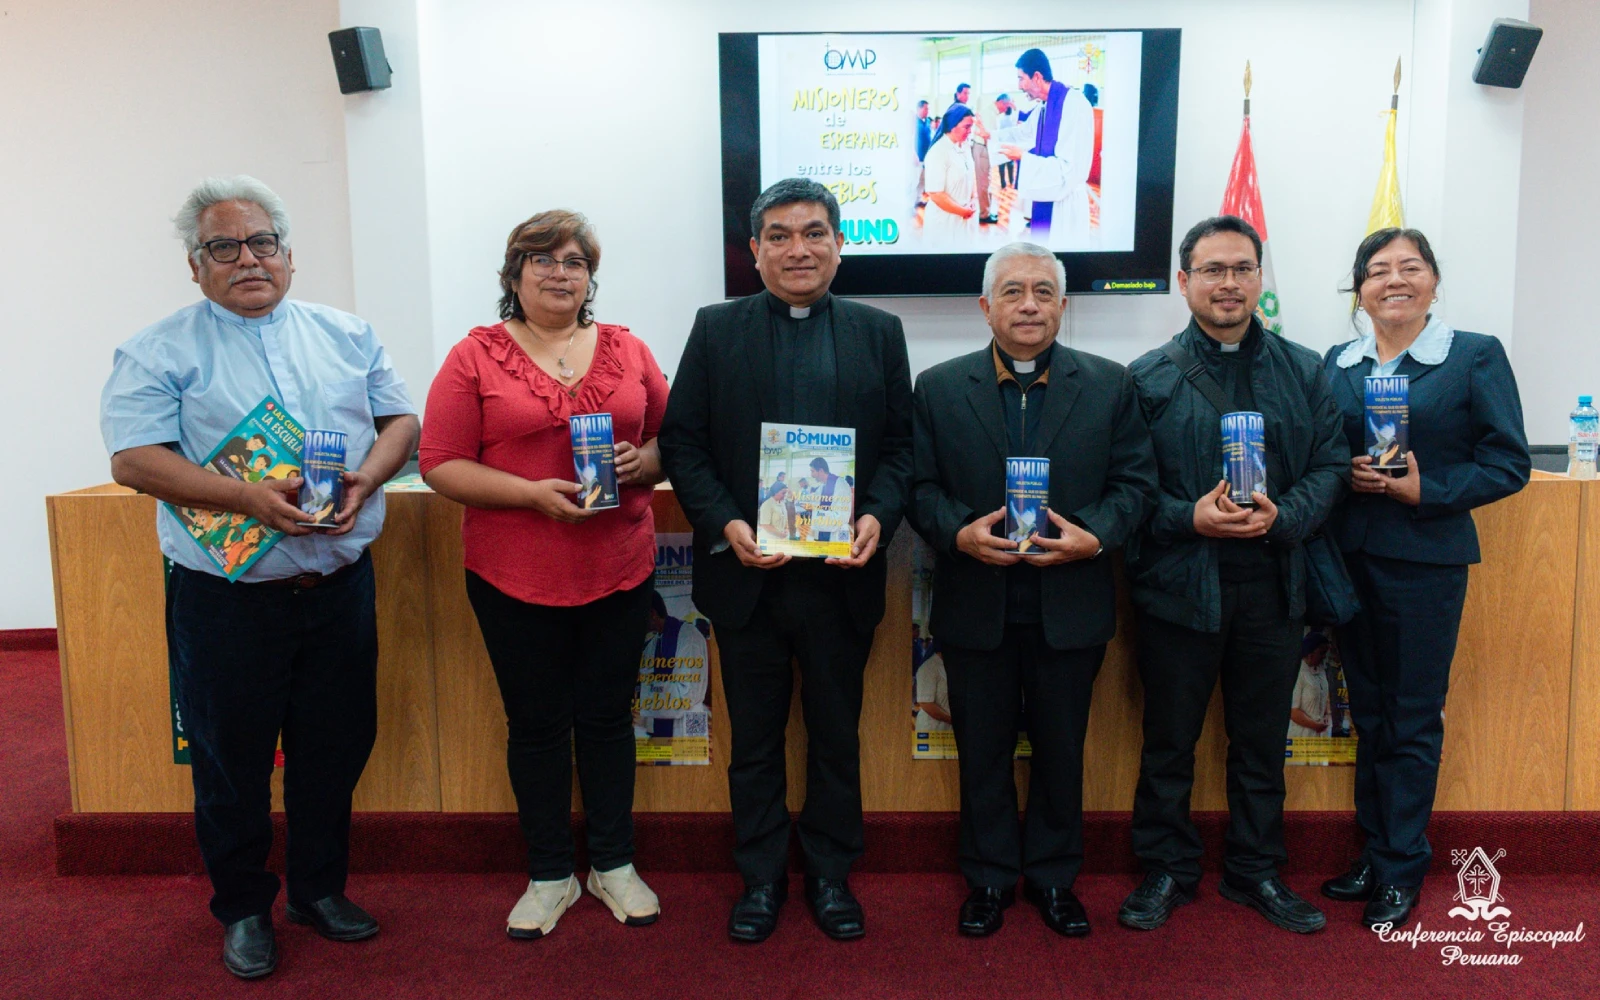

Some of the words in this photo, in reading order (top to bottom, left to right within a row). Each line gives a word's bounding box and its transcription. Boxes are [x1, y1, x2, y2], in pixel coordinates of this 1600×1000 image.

[792, 86, 899, 112] MISIONEROS
[825, 112, 846, 127] de
[820, 131, 899, 150] ESPERANZA
[797, 161, 842, 176] entre
[848, 162, 872, 176] los
[1111, 281, 1143, 289] Demasiado
[1143, 281, 1157, 290] bajo
[261, 413, 272, 426] LA
[271, 424, 303, 454] ESCUELA
[273, 408, 286, 422] LAS
[284, 418, 305, 442] CUATR
[786, 428, 851, 446] DOMUND
[639, 654, 704, 668] ioneros
[631, 692, 691, 711] ueblos
